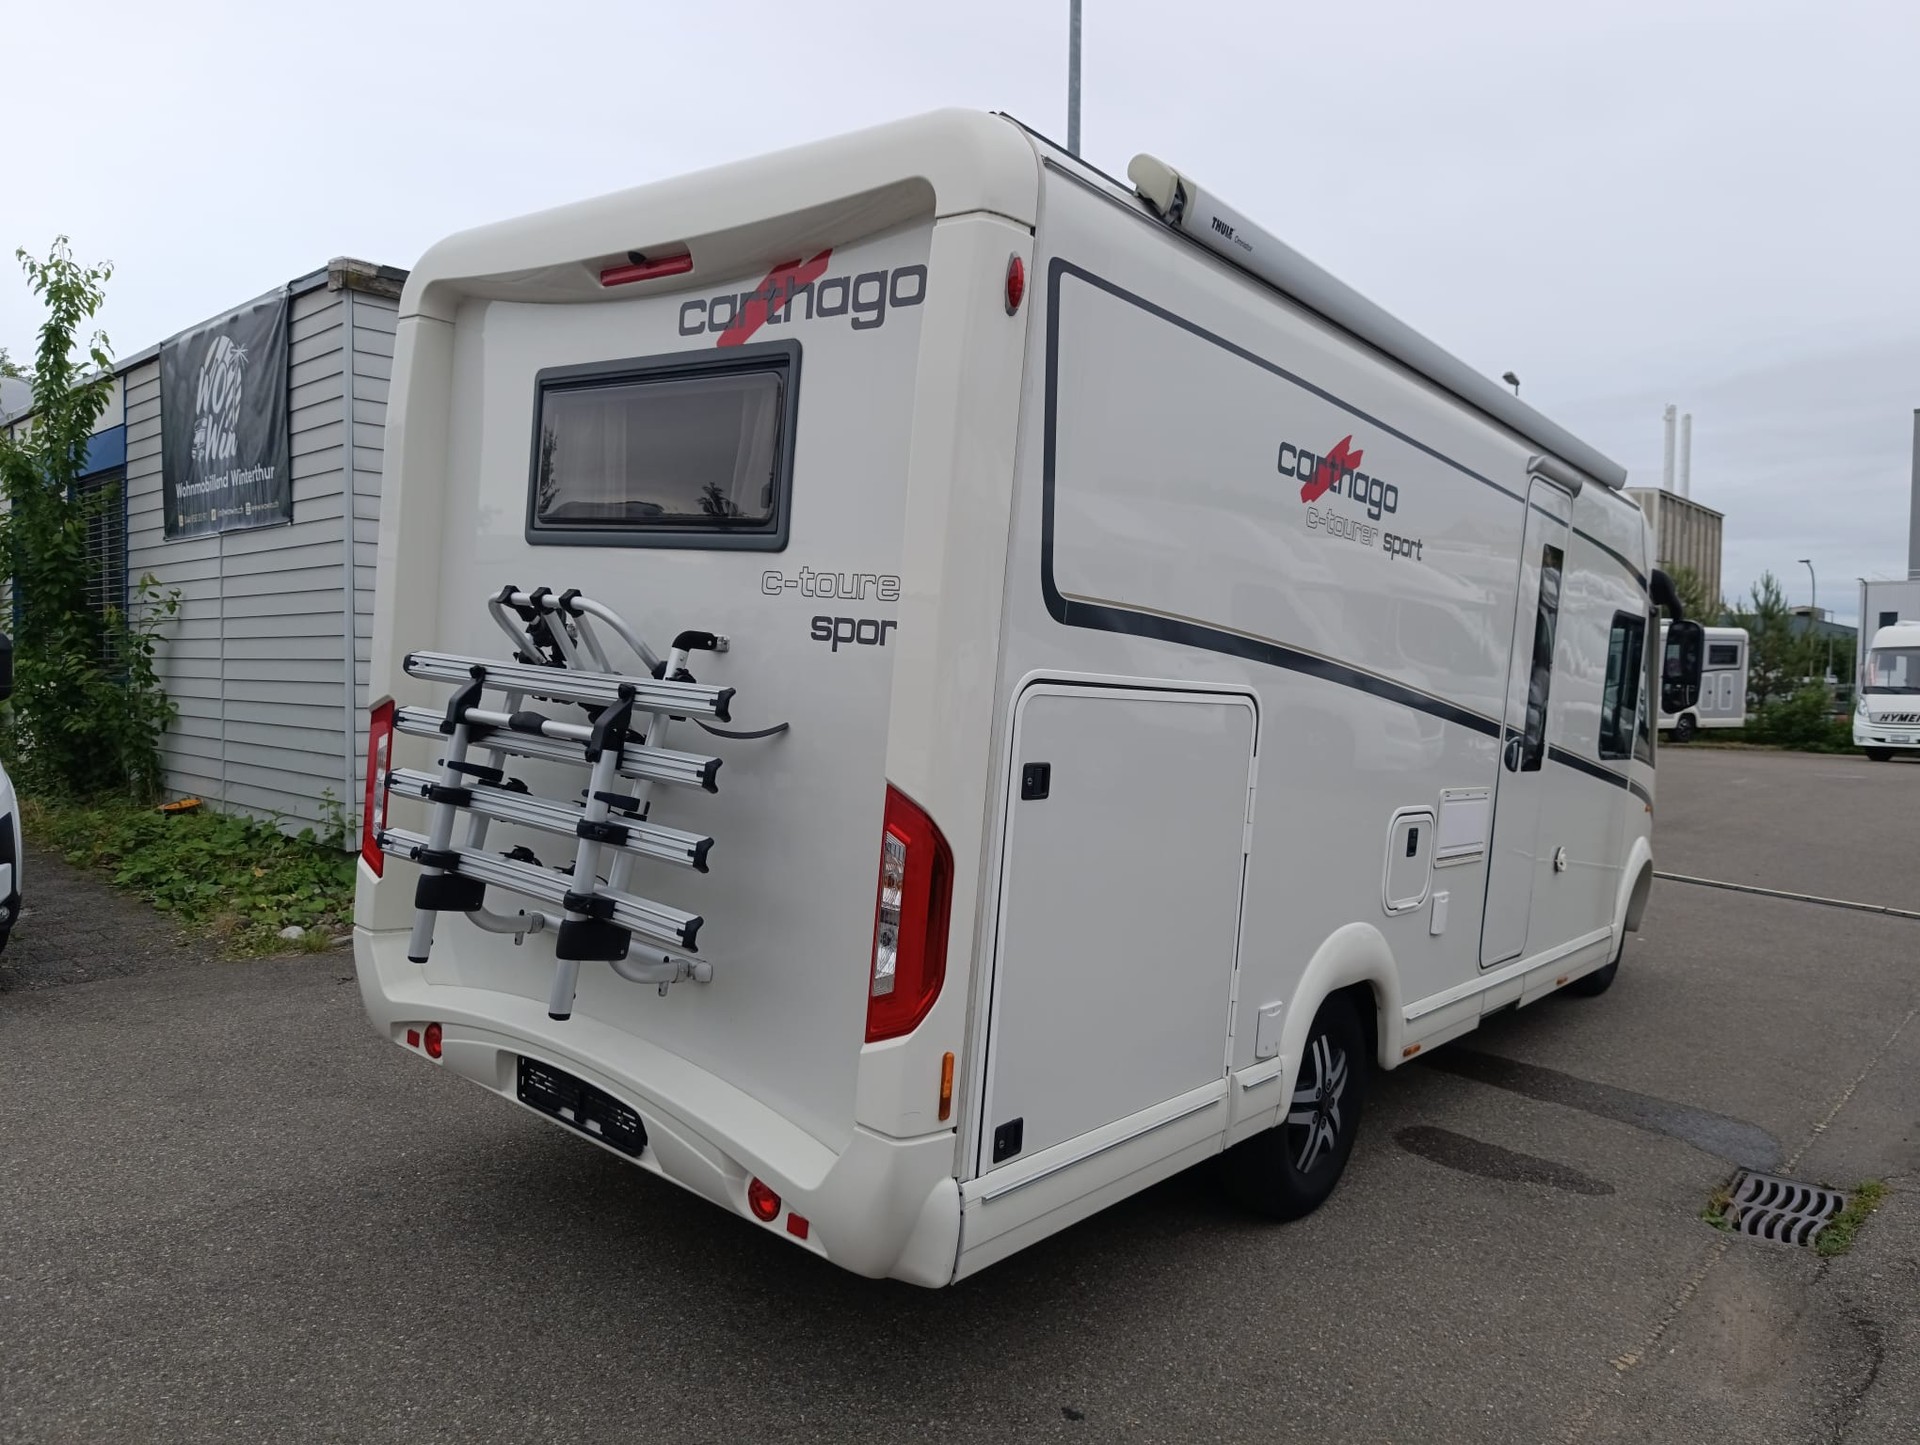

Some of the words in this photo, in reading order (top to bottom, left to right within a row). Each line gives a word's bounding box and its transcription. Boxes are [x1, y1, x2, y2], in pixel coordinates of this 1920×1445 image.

[1211, 216, 1234, 240] THULE
[678, 264, 928, 336] carthago
[230, 463, 275, 487] Winterthur
[1277, 441, 1398, 521] carthago
[1306, 506, 1378, 546] c-tourer
[1383, 532, 1423, 561] sport
[761, 566, 900, 601] c-toure
[810, 615, 898, 652] spor
